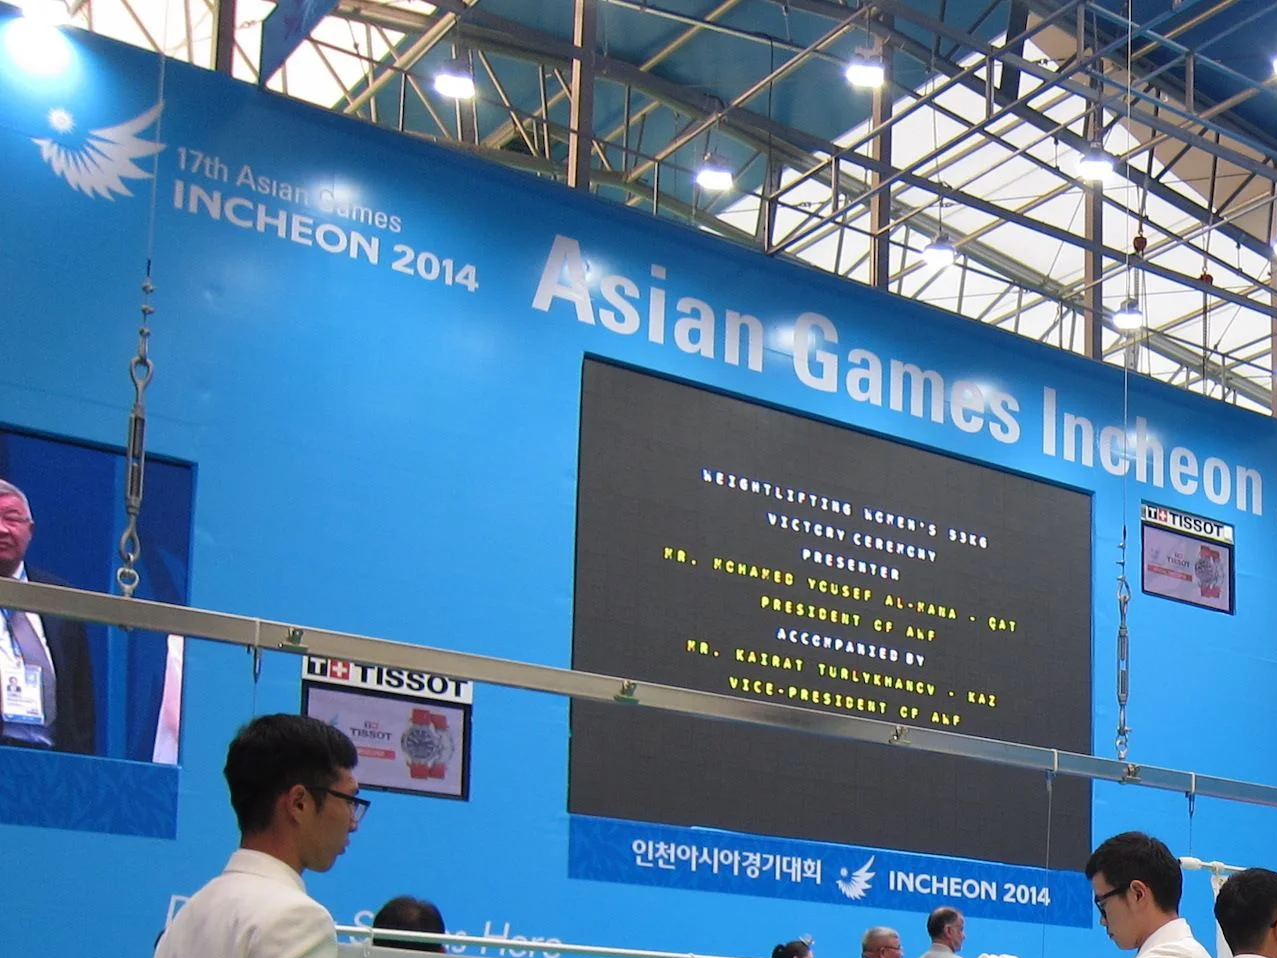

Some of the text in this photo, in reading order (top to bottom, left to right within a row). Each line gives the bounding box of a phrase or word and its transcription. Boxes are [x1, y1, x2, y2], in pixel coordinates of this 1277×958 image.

[177, 146, 229, 184] 17th
[236, 164, 309, 206] Asian
[173, 181, 480, 293] INCHEON 2014
[531, 235, 765, 373] Asian
[792, 311, 1021, 445] Games
[1043, 386, 1264, 517] Incheon
[703, 468, 852, 517] WEIGHTLIFTING
[1169, 512, 1224, 537] TISSOT
[802, 548, 900, 582] PRESENTER
[761, 596, 861, 628] PRESIDENT
[736, 648, 804, 673] KAIRAT
[968, 691, 998, 708] KAZ
[905, 652, 926, 668] BY
[354, 662, 468, 698] TISSOT
[729, 676, 888, 715] VICE-PRESIDENT
[350, 727, 392, 741] TISSOT
[632, 838, 823, 886] 인천아시아경기대회
[888, 870, 1051, 906] INCHEON 2014
